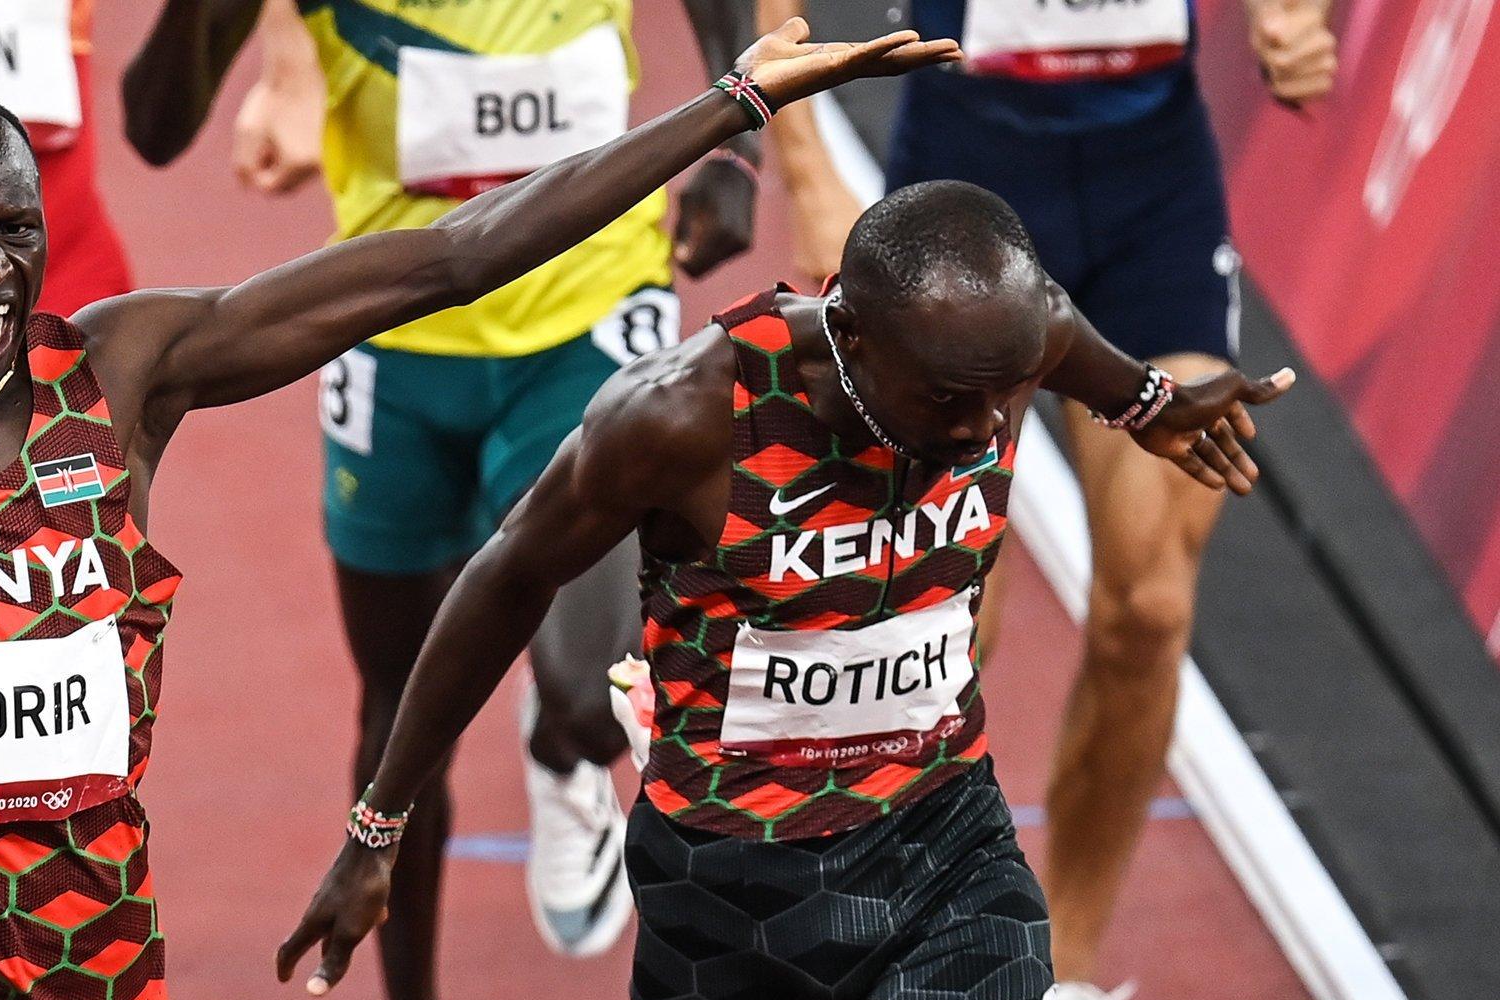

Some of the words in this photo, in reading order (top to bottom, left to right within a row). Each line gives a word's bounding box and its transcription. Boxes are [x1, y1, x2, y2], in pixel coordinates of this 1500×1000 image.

[475, 87, 572, 136] BOL
[622, 303, 663, 357] 8
[768, 485, 991, 582] KENYA
[762, 634, 949, 706] ROTICH
[7, 796, 38, 809] 2020
